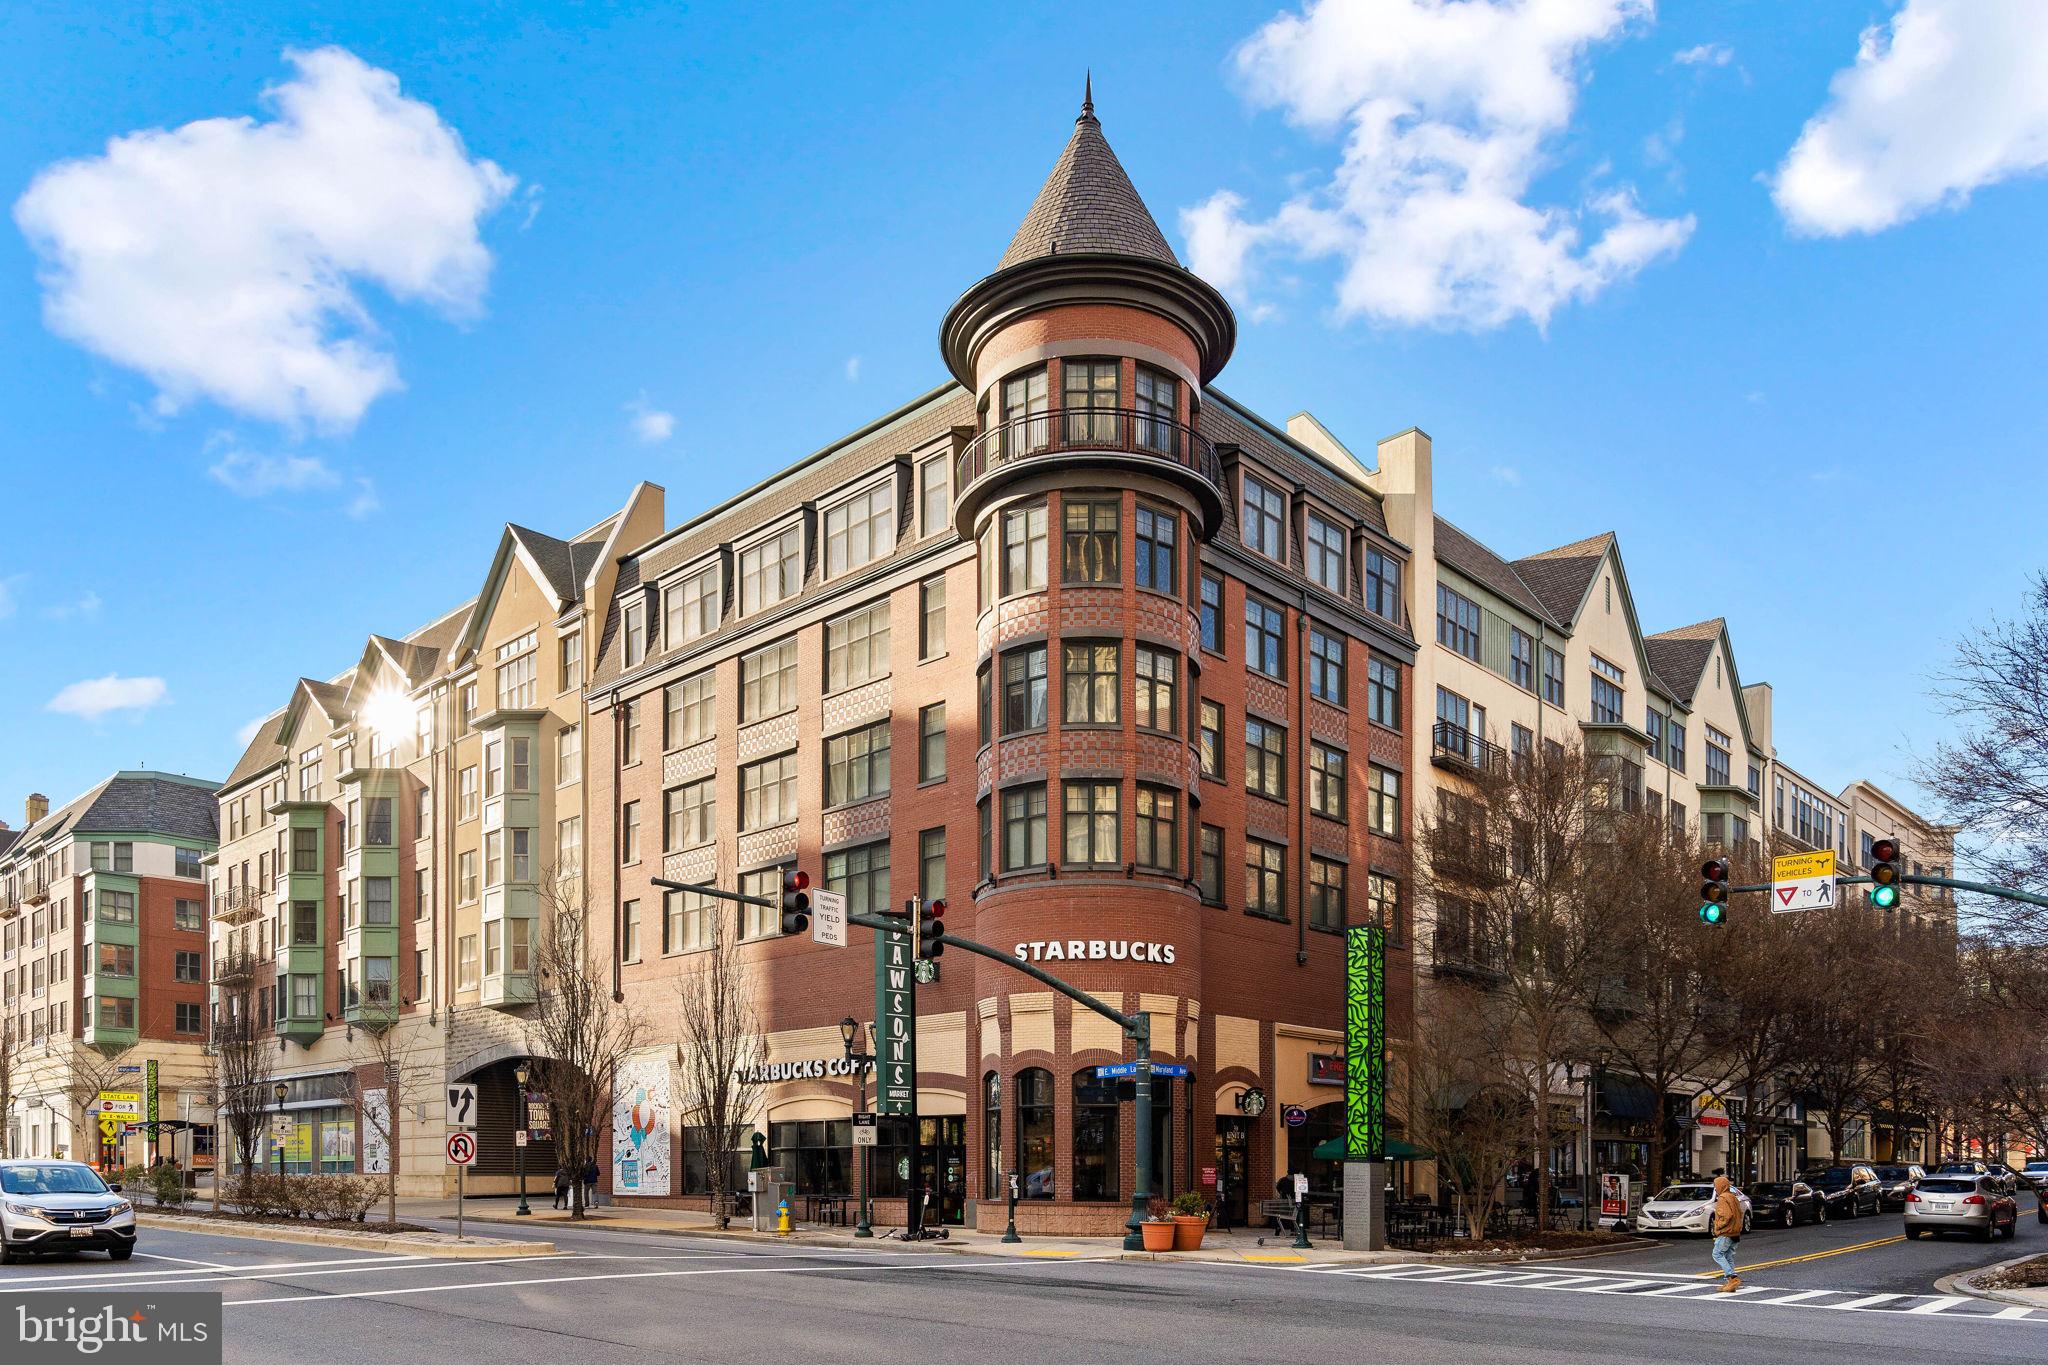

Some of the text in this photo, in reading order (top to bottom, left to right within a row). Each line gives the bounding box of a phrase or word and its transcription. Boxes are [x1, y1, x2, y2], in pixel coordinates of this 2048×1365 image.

[1776, 857, 1813, 867] TURNING
[1776, 867, 1812, 877] VEHICLES
[1802, 889, 1812, 897] TO
[819, 894, 840, 904] TURNING
[820, 904, 839, 913] TRAFFIC
[819, 913, 840, 923] YIELD
[821, 931, 838, 941] PEDS
[1013, 939, 1176, 964] STARBUCKS
[827, 1056, 878, 1077] COF
[1111, 1067, 1128, 1075] Middle
[1155, 1065, 1188, 1075] Maryland Ave
[889, 1090, 910, 1099] MARKET
[529, 1110, 550, 1120] TOWN
[529, 1121, 550, 1129] SQUARE
[857, 1136, 872, 1144] ONLY
